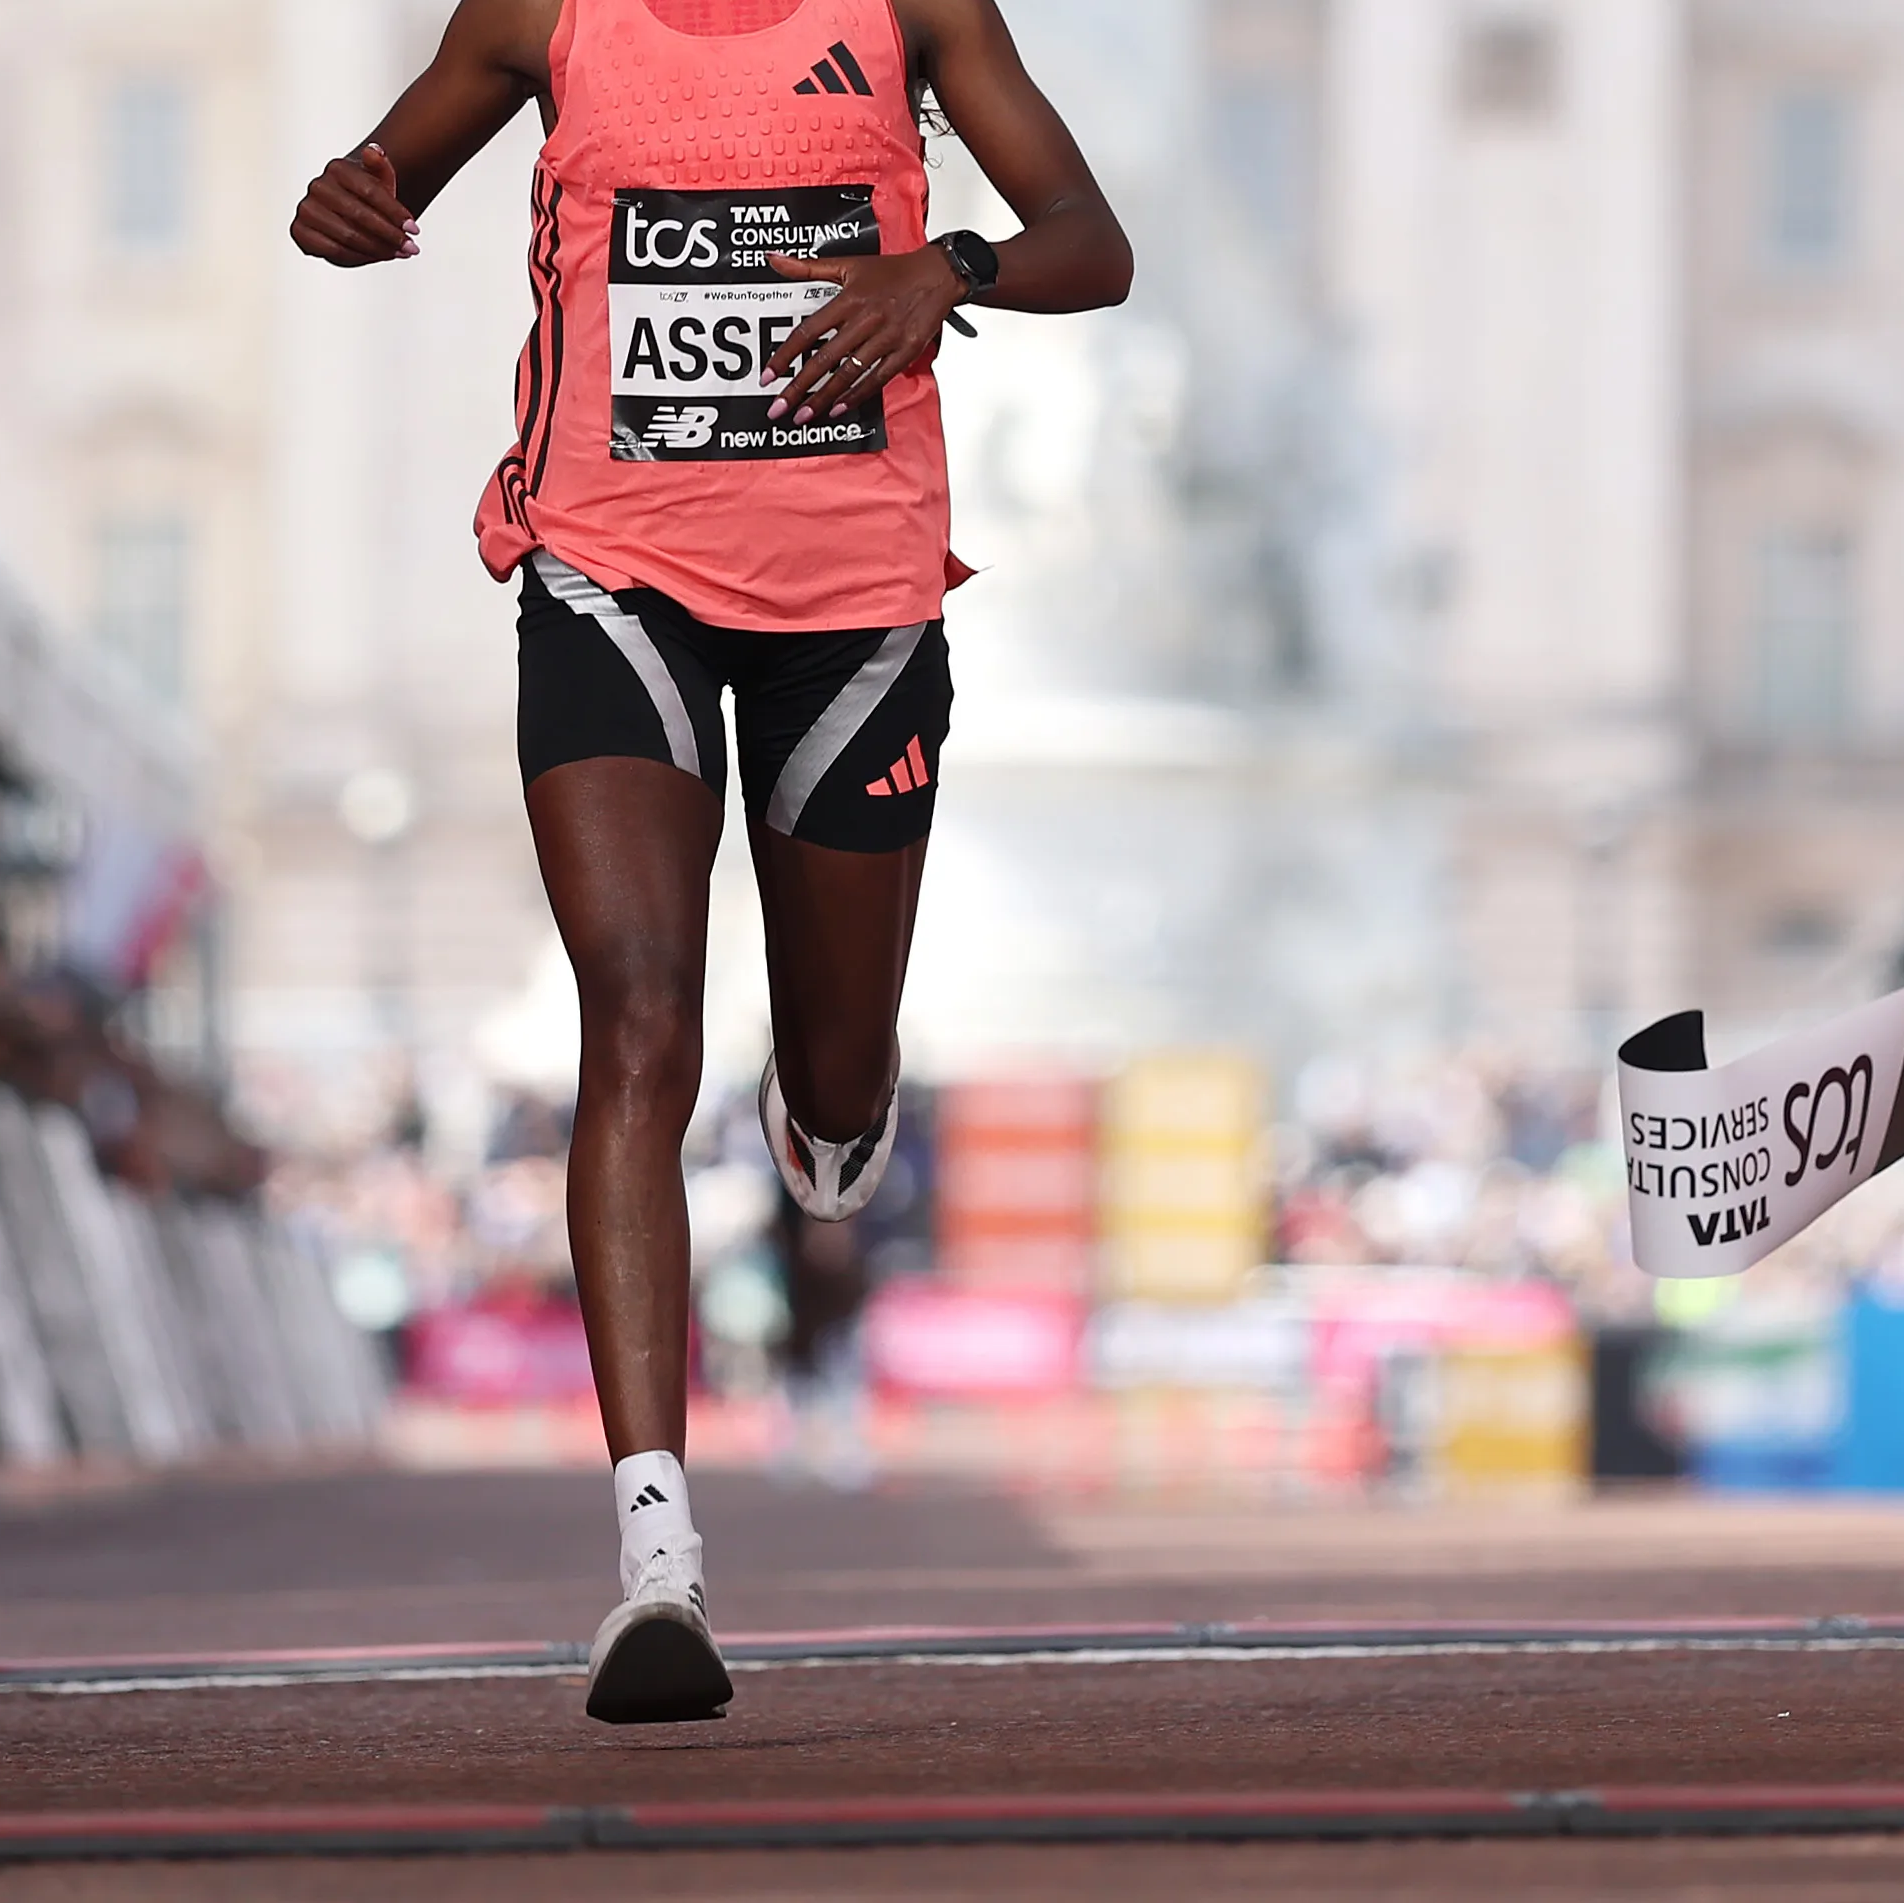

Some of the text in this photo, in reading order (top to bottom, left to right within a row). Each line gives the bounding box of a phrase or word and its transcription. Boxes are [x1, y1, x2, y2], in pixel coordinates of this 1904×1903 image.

[730, 205, 791, 223] TATA
[730, 221, 860, 246] CONSULTANCY
[625, 206, 719, 268] tcs
[703, 290, 794, 303] #WeRunTogether
[720, 421, 863, 448] new balance
[1630, 1096, 1770, 1151] SERVICES
[1783, 1053, 1873, 1187] tcs
[1686, 1195, 1771, 1247] TATA
